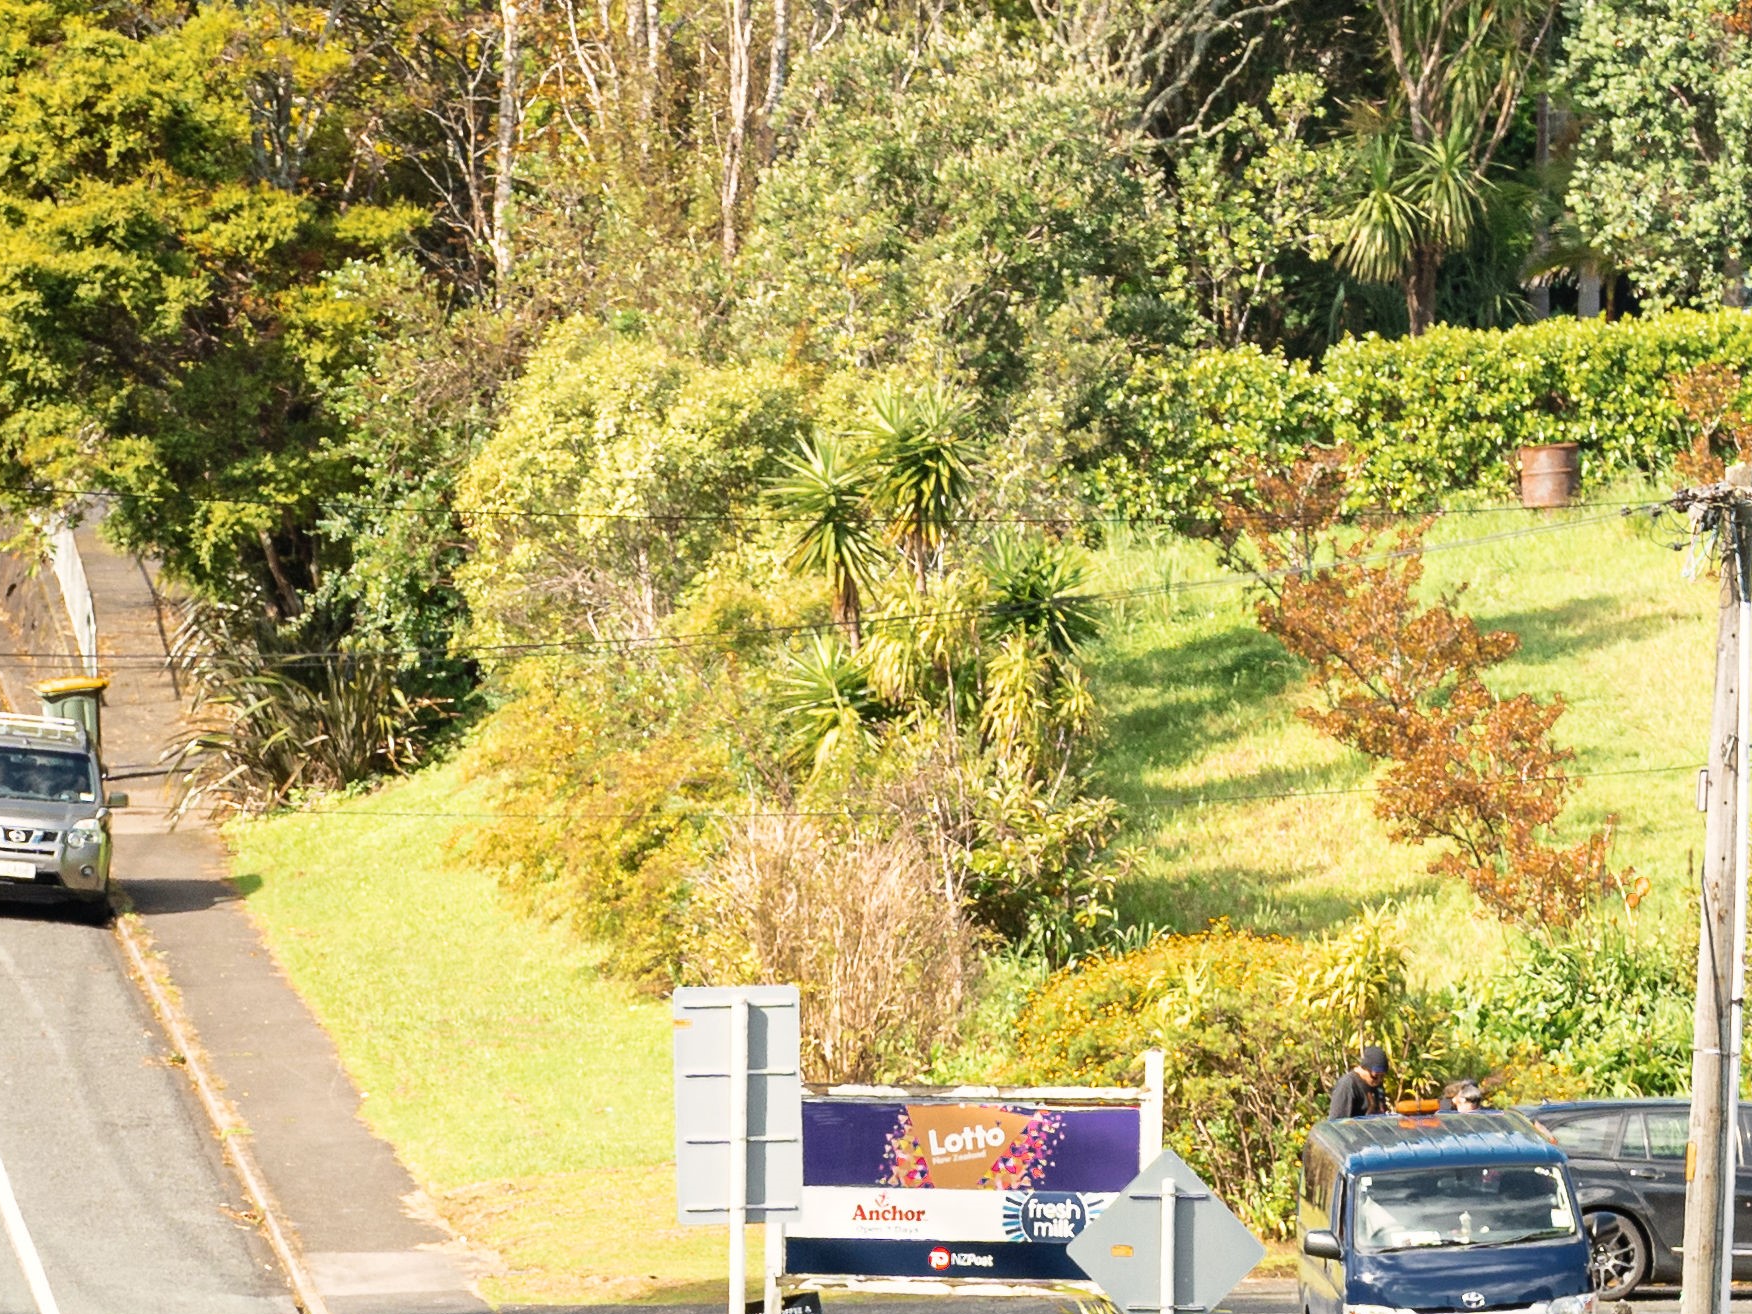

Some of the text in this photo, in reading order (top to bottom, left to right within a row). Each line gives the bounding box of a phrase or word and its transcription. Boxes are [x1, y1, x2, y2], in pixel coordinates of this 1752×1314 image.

[928, 1124, 1006, 1157] Lotto
[852, 1204, 926, 1222] Anchor
[1027, 1198, 1081, 1220] fresh
[1033, 1218, 1076, 1239] milk
